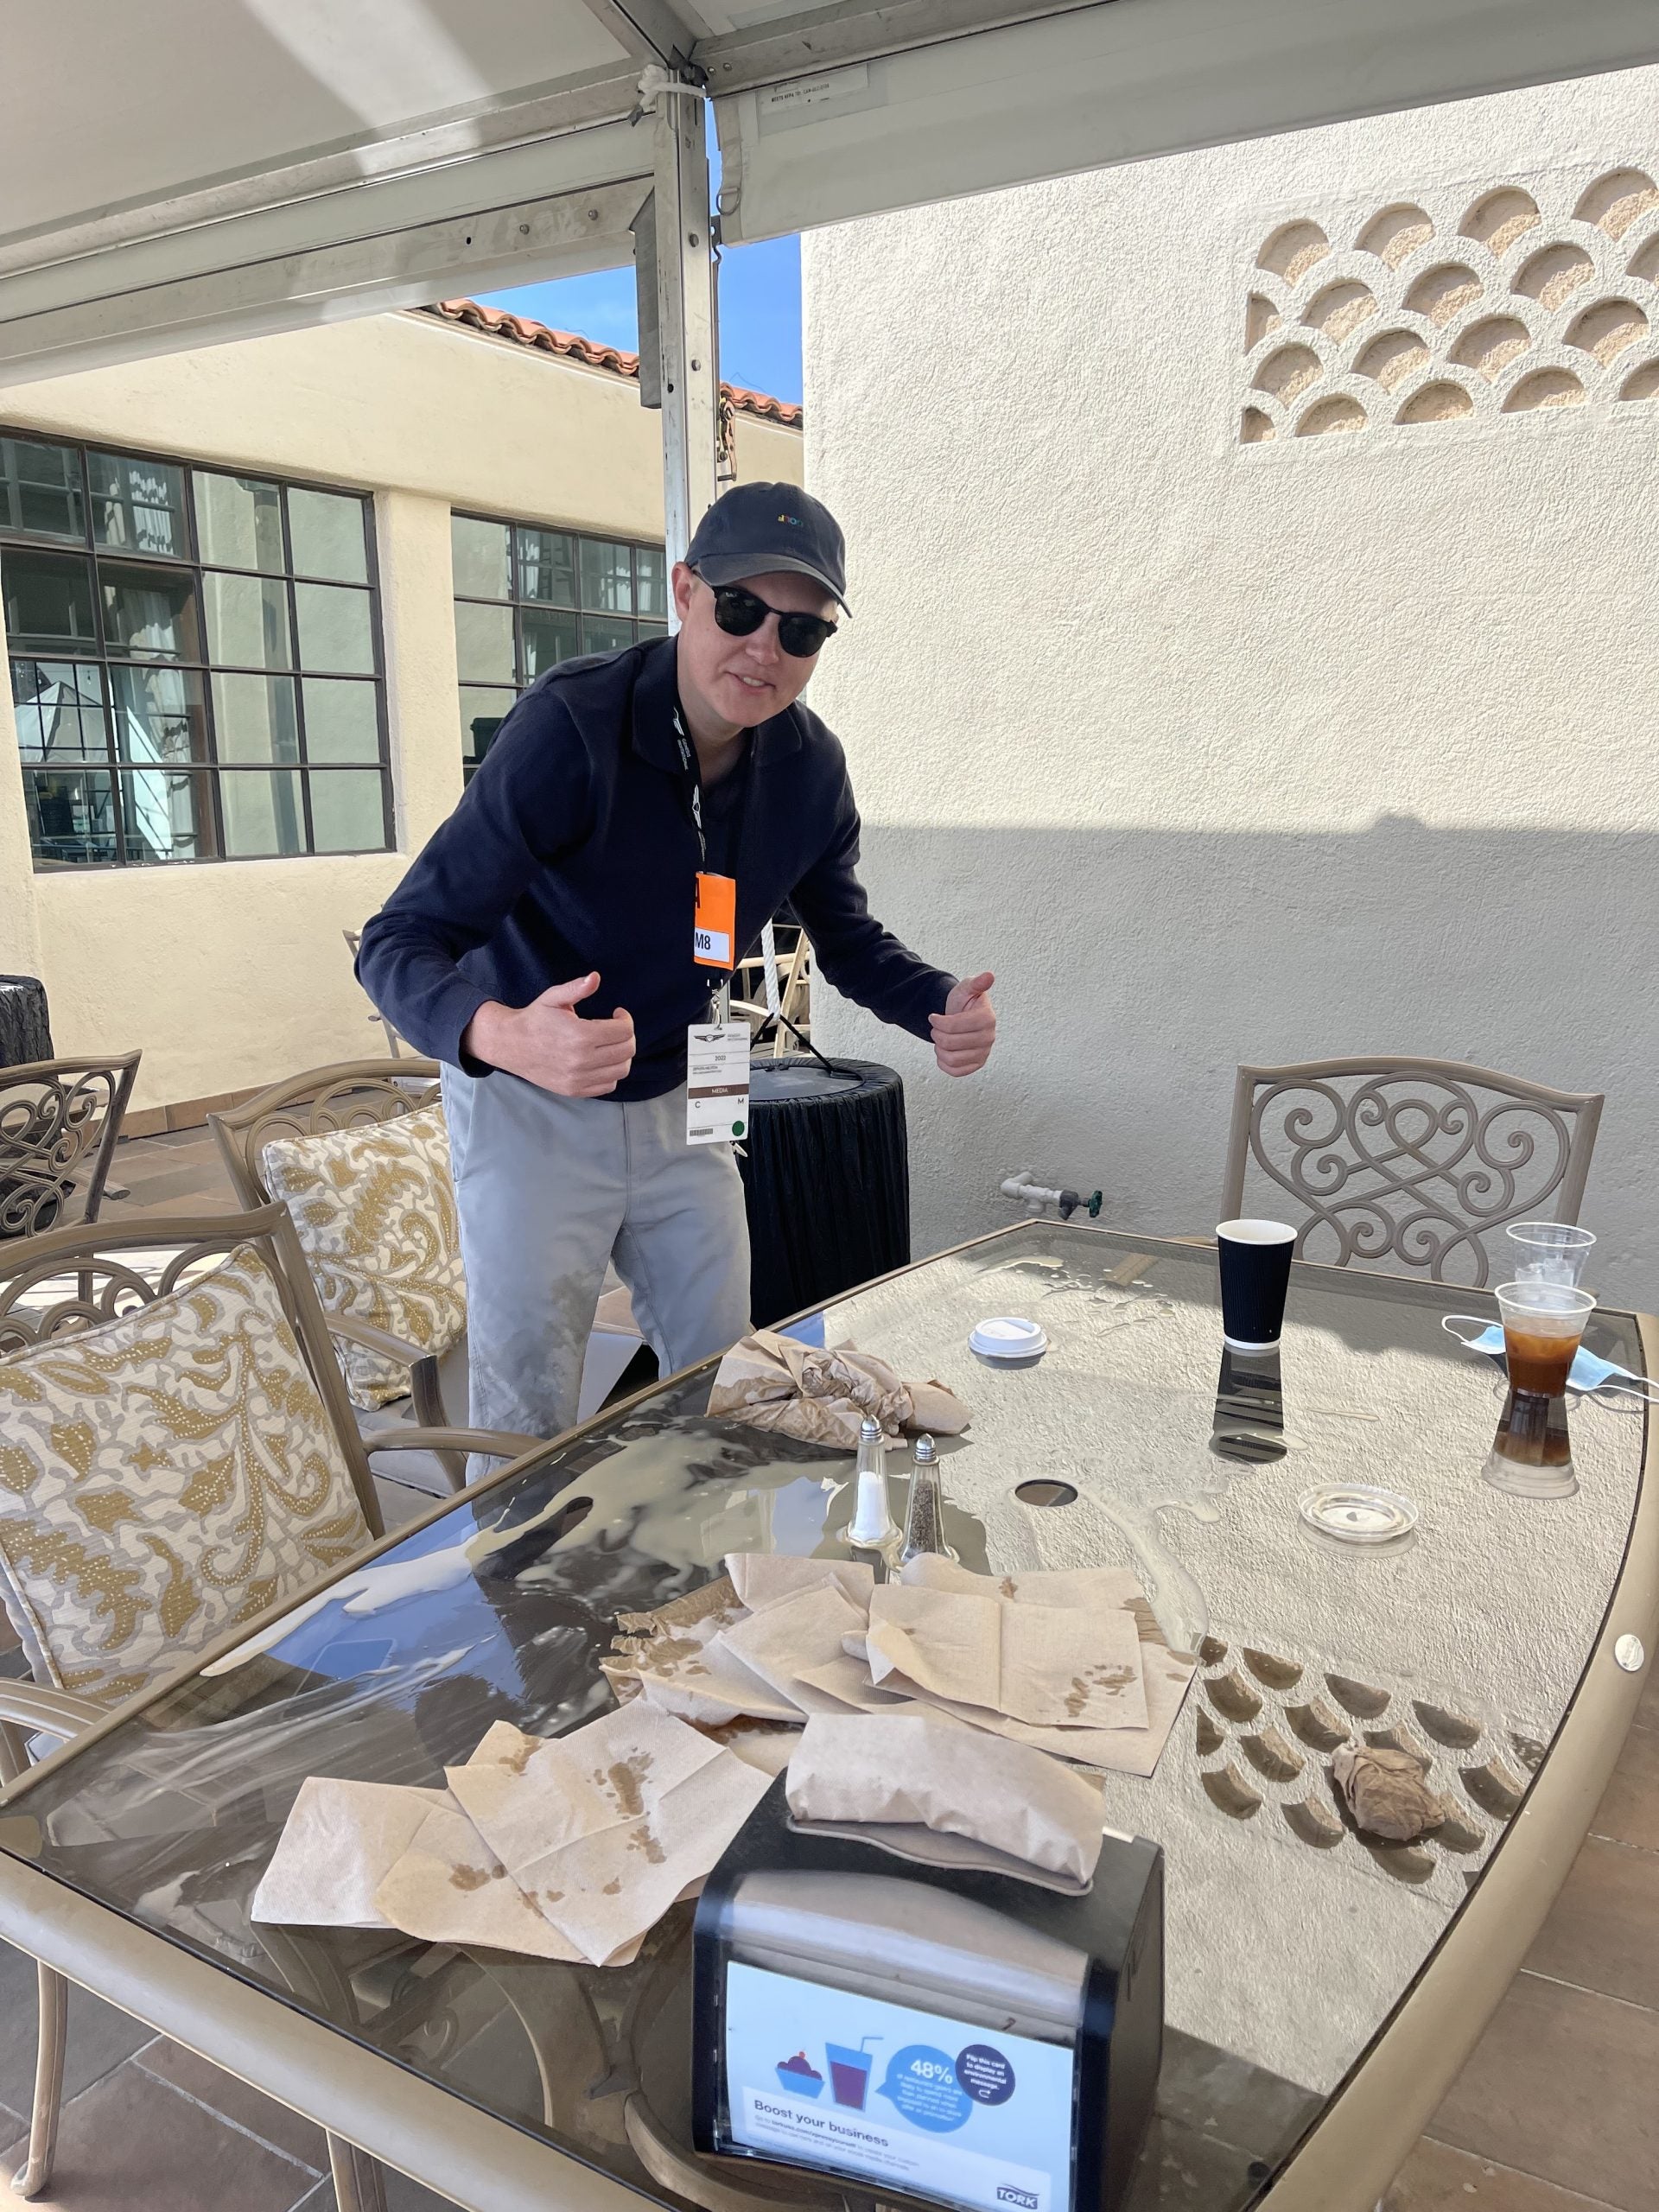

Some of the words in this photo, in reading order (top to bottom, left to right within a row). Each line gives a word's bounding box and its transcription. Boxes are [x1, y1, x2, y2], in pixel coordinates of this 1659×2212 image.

[910, 2059, 953, 2084] 48%
[754, 2100, 792, 2118] Boost
[796, 2113, 825, 2128] your
[829, 2121, 889, 2146] business
[998, 2189, 1036, 2209] TORK
